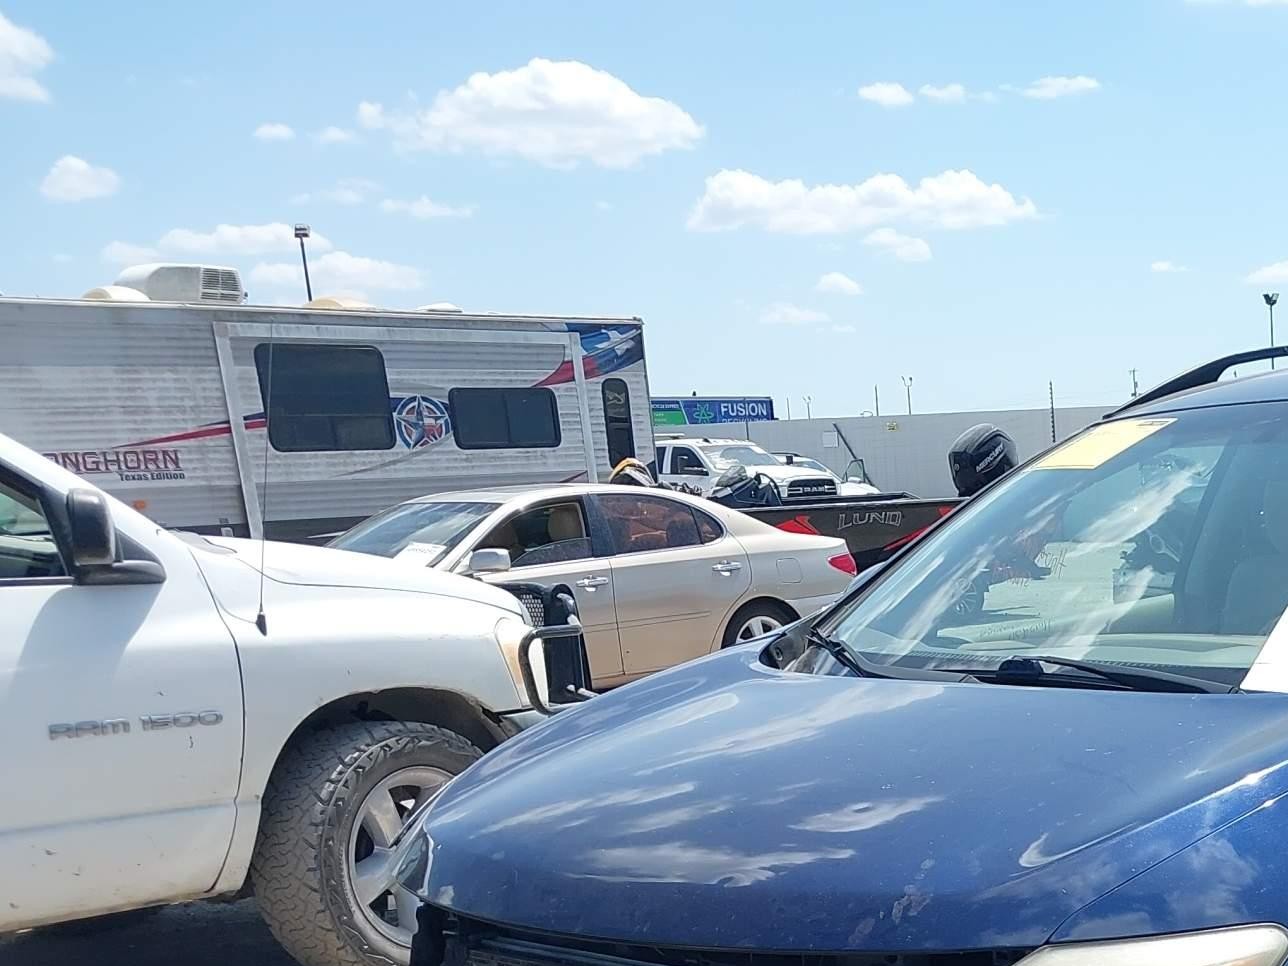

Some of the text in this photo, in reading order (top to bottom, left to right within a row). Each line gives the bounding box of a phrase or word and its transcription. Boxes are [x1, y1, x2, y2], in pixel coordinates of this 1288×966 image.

[720, 402, 767, 417] FUSION
[118, 472, 185, 481] Texas Edition
[837, 511, 902, 530] LUND
[140, 710, 224, 732] 1500
